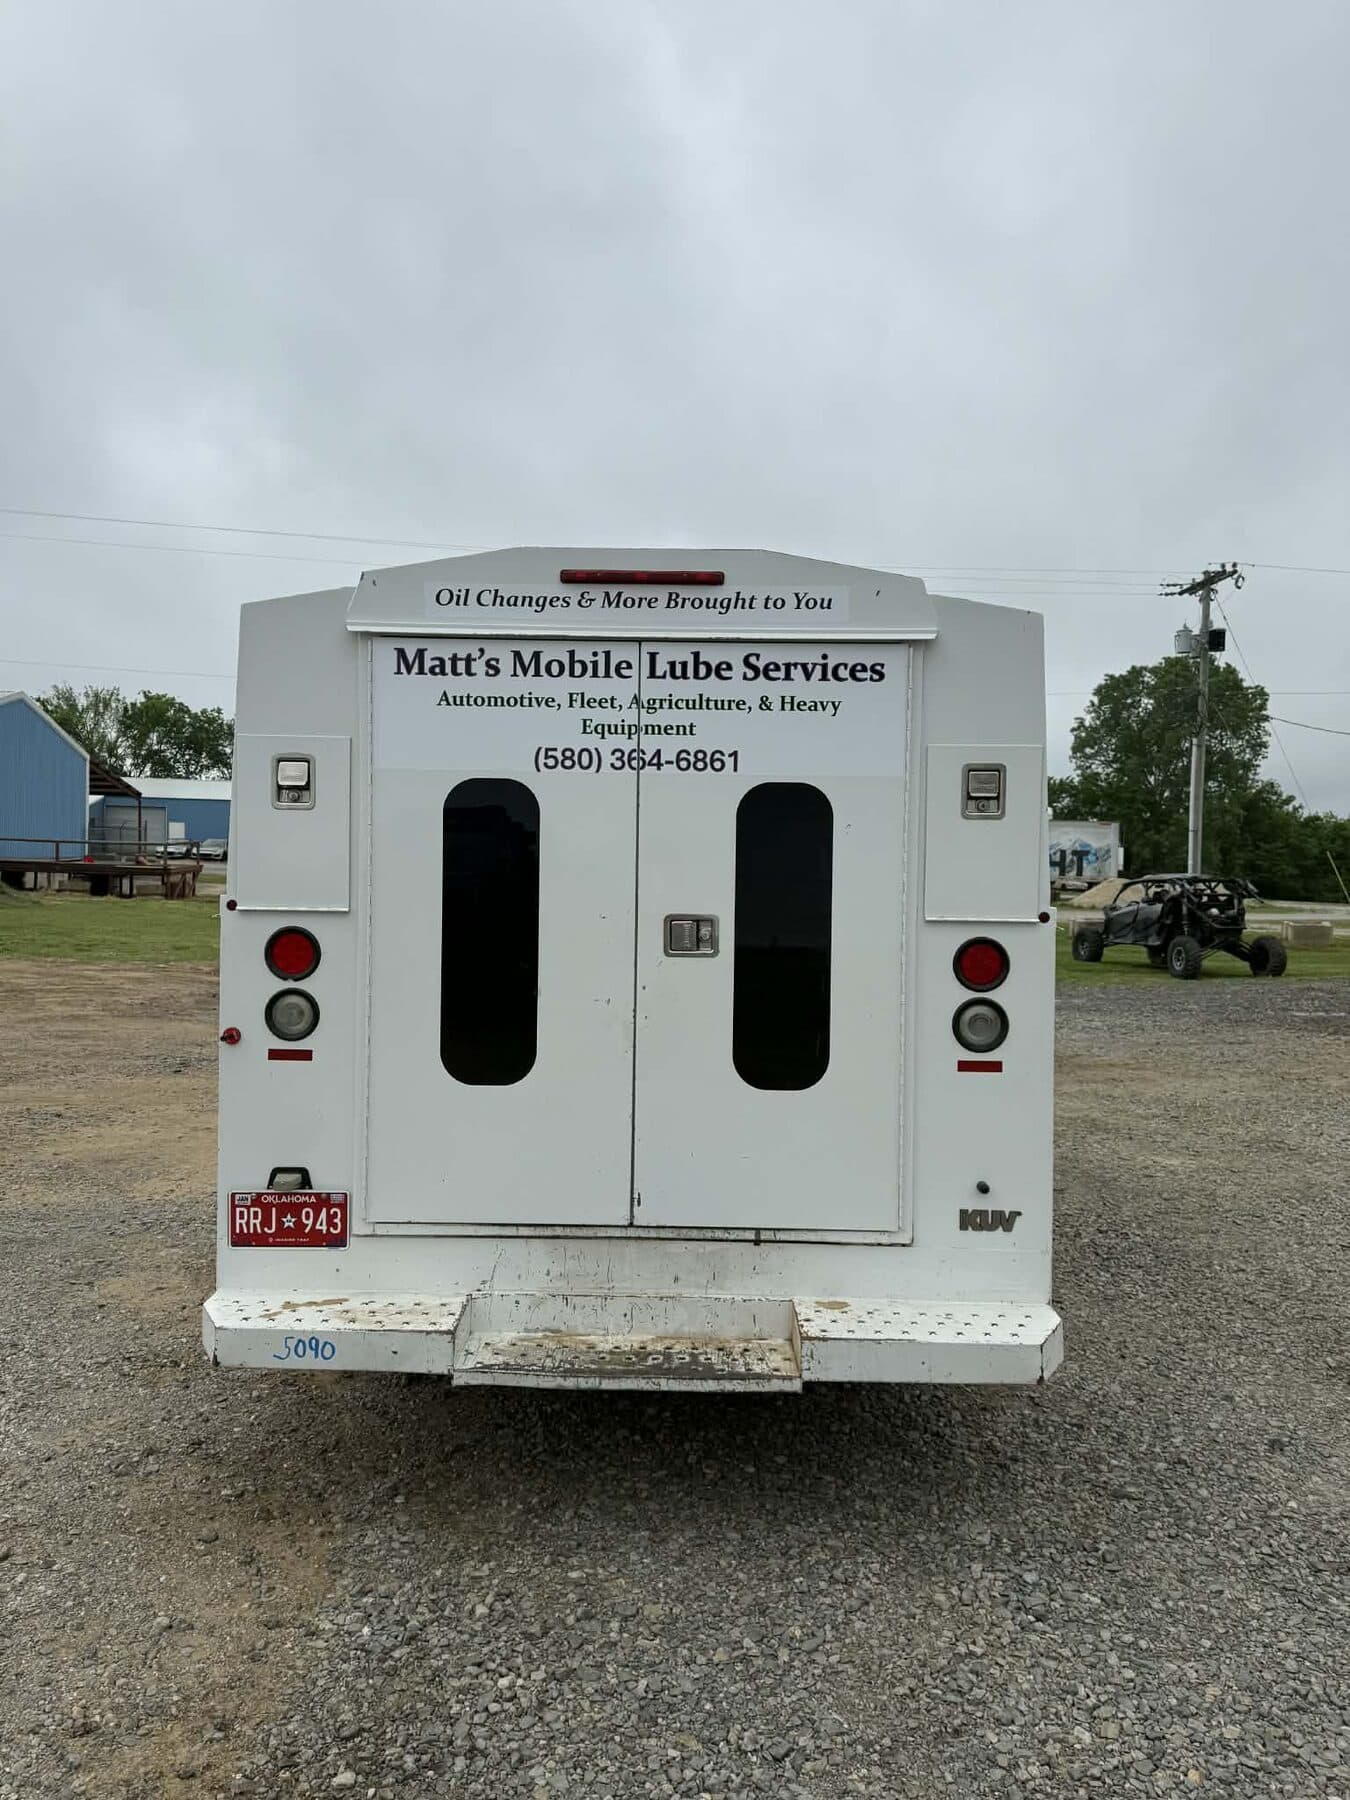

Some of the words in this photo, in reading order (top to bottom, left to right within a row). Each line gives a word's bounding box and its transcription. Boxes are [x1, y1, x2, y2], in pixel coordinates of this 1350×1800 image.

[435, 588, 470, 607] Oil
[476, 588, 572, 613] Changes
[577, 590, 596, 608] &
[601, 590, 658, 609] More
[665, 590, 757, 615] Brought
[763, 594, 786, 610] to
[793, 592, 833, 610] You
[510, 649, 633, 679] Mobile
[646, 650, 733, 680] Lube
[742, 652, 886, 683] Services
[436, 690, 562, 711] Automotive,
[567, 692, 623, 712] Fleet,
[627, 692, 752, 714] Agriculture,
[758, 695, 774, 711] &
[780, 695, 842, 716] Heavy
[580, 718, 697, 740] Equipment
[534, 746, 603, 773] (580)
[609, 748, 739, 773] 364-6861
[261, 1194, 317, 1204] OKLAHOMA
[235, 1207, 277, 1234] RRJ
[301, 1207, 342, 1234] 943
[959, 1208, 1023, 1232] KUV
[273, 1336, 336, 1361] 5090
